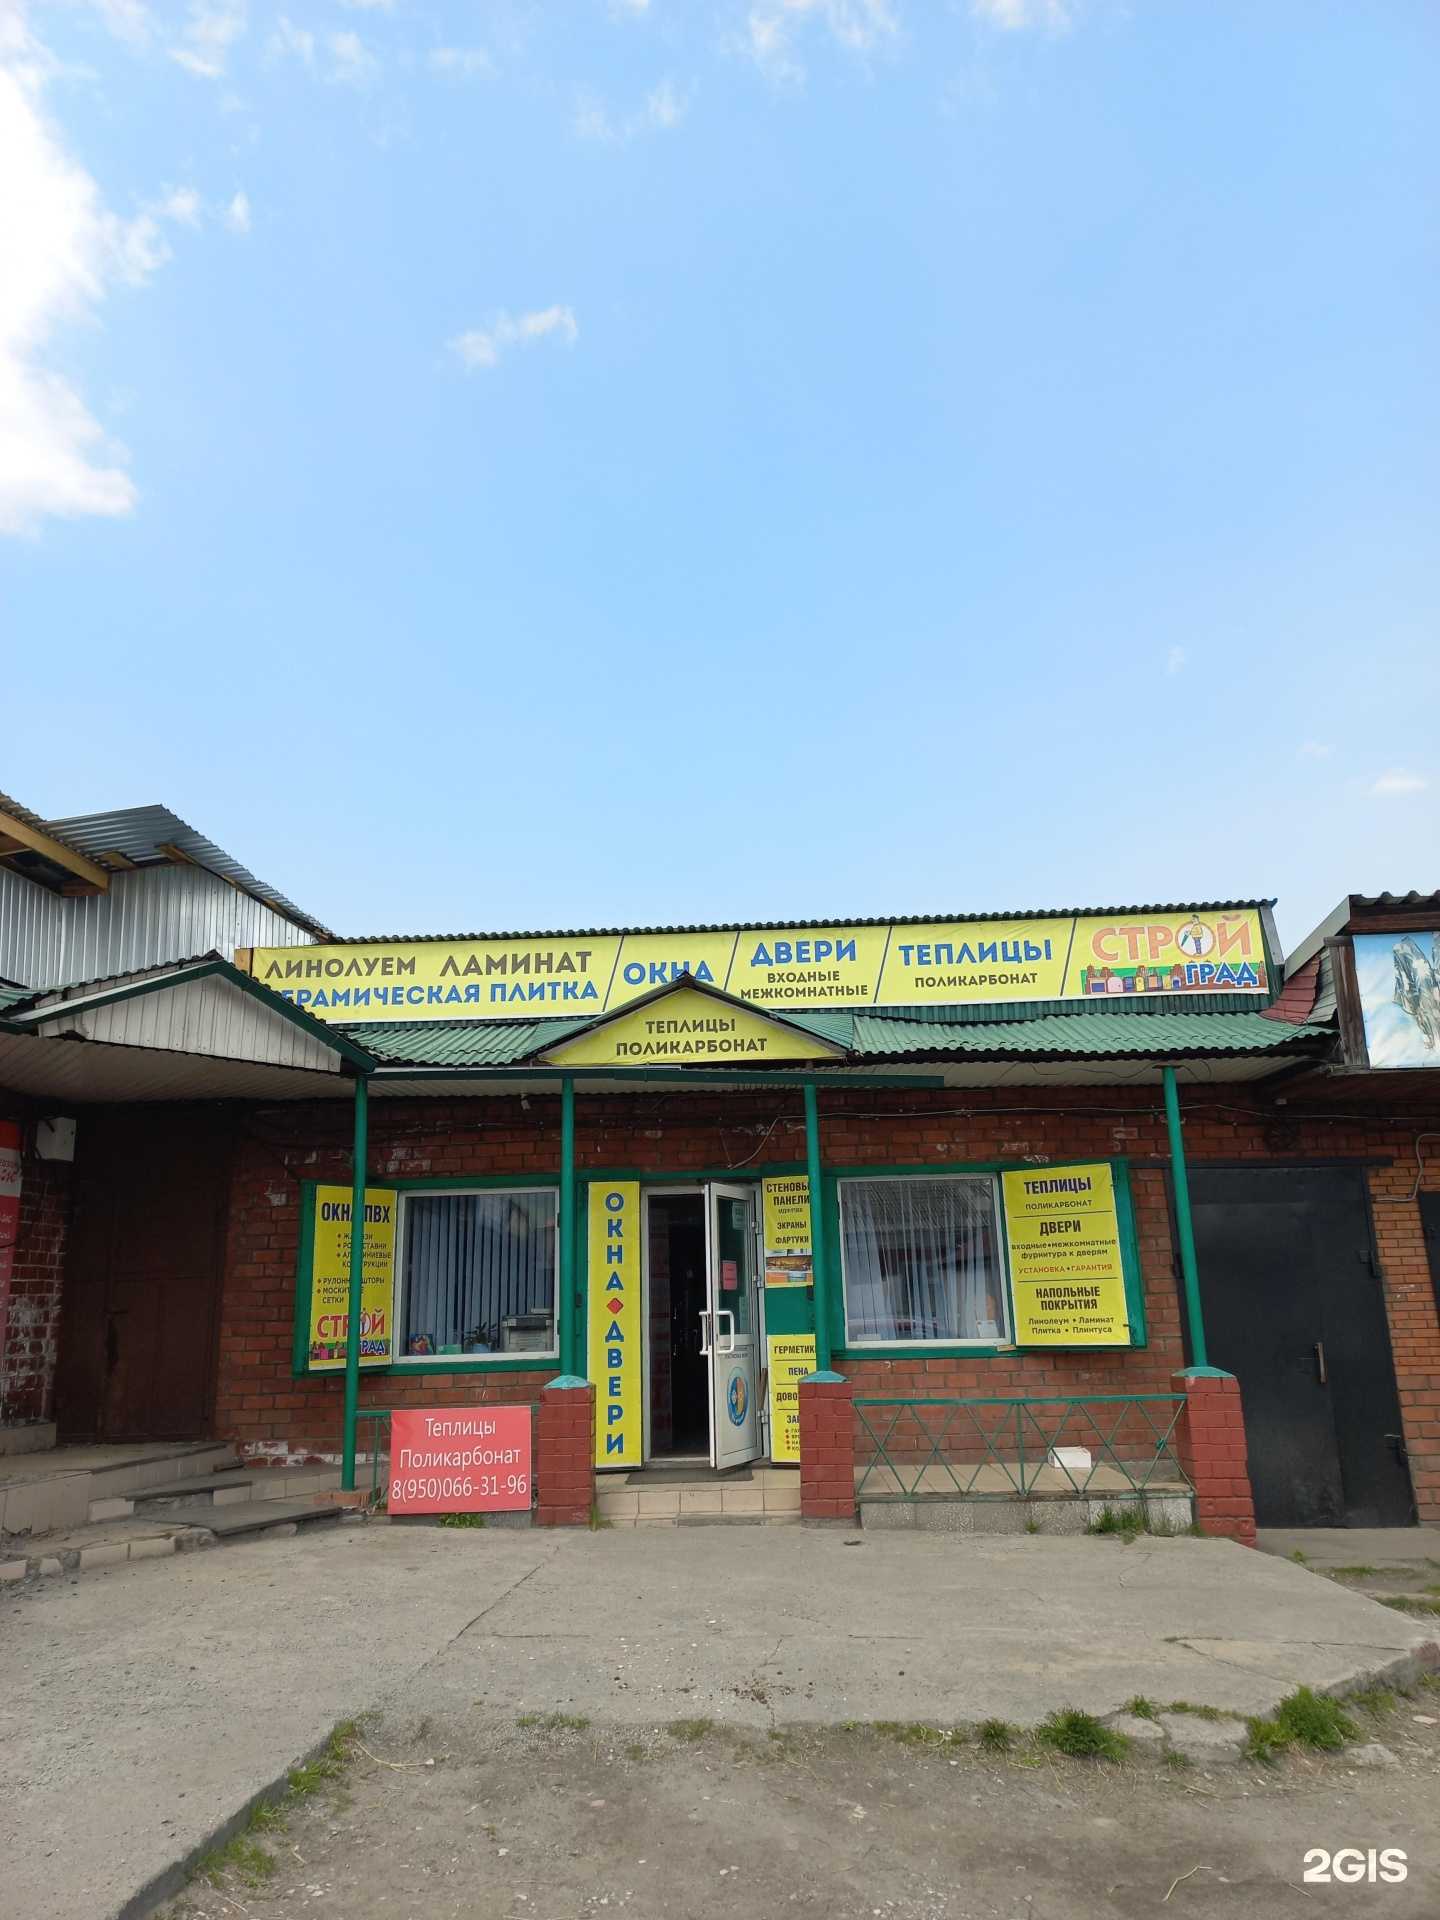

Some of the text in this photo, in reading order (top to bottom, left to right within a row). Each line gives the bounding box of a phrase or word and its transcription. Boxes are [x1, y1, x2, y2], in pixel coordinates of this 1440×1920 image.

[1091, 914, 1252, 962] СТРОЙ
[750, 939, 857, 967] ДВЕРИ
[898, 939, 1052, 966] ТЕПЛИЦЫ
[265, 951, 592, 979] ЛИНОЛУЕМ ЛАМИНАТ
[767, 970, 840, 984] ВХОДНЫЕ
[914, 972, 1038, 989] ПОЛИКАРБОНАТ
[1185, 961, 1259, 987] ГРАД
[281, 981, 598, 1008] РАМИЧЕСКАЯ ПЛИТКА
[740, 985, 868, 1000] МЕЖКОМНАТНЫЕ
[645, 1018, 736, 1036] ТЕПЛИЦЫ
[616, 1038, 768, 1057] ПОЛИКАРБОНАТ
[766, 1182, 810, 1193] СТЕНОВЫ
[1024, 1177, 1092, 1195] ТЕПЛИЦЫ
[773, 1194, 810, 1206] ПАНЕЛИ
[1025, 1199, 1093, 1211] ПОЛИКАРБОНАТ
[321, 1202, 390, 1224] ОКН ПВХ
[777, 1221, 807, 1229] ЭКРАНЫ
[1039, 1219, 1082, 1237] ДВЕРИ
[776, 1235, 809, 1244] ФАРТУКИ
[342, 1261, 388, 1269] КОРУКЦИИ
[1018, 1263, 1113, 1275] УСТАНОВКА ГАРАНТИЯ
[1036, 1286, 1100, 1298] НАПОЛЬНЫЕ
[1041, 1299, 1098, 1312] ПОКРЫТИЯ
[605, 1192, 625, 1455] ОКНА ДВЕРИ
[1028, 1316, 1114, 1329] Линолеум Ламинат
[1032, 1325, 1112, 1335] Плитка Плинтуса
[361, 1340, 384, 1355] РАД
[774, 1344, 816, 1354] ГЕРМЕТИК
[788, 1367, 809, 1375] ПЕНА
[425, 1417, 496, 1438] Теплицы
[400, 1445, 521, 1471] Поликарбонат
[392, 1474, 527, 1503] 8(950)066-31-96
